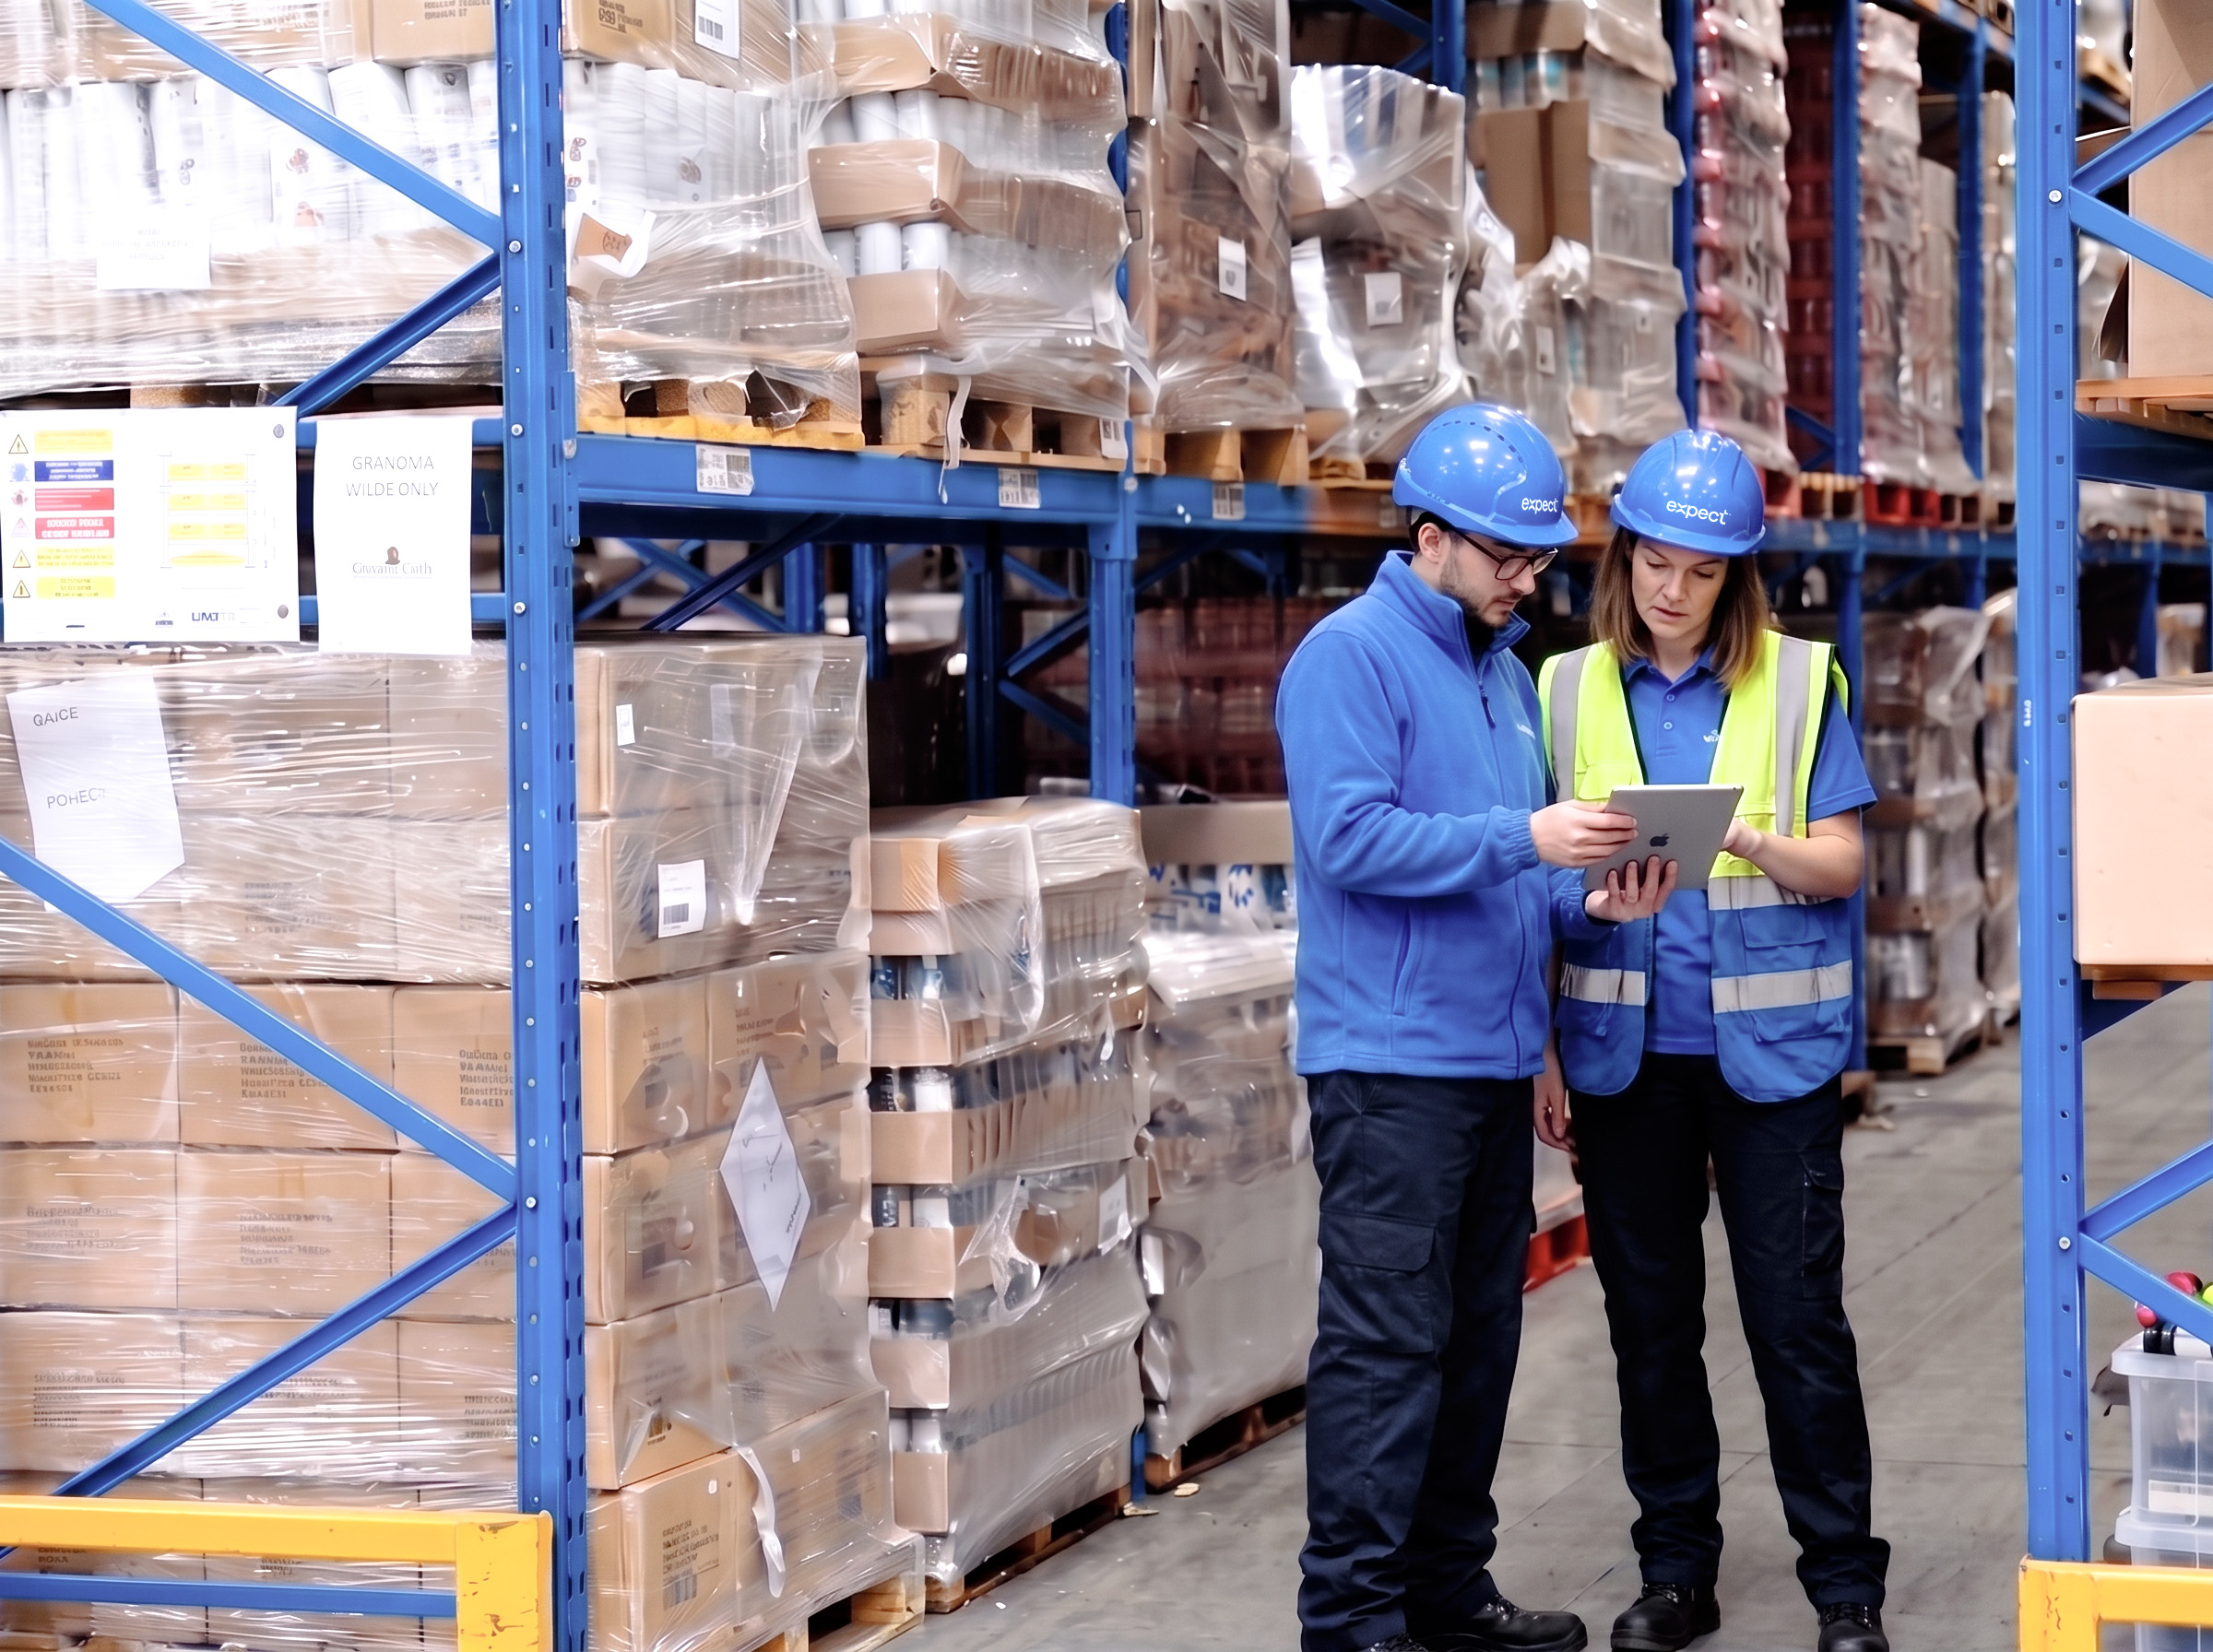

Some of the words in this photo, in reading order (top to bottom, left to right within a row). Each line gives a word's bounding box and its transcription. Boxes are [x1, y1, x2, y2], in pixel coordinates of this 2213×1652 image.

[352, 455, 434, 470] GRANOMA
[346, 482, 394, 497] WILDE
[398, 481, 439, 496] ONLY
[1521, 497, 1559, 514] expect
[1665, 500, 1729, 525] expect
[33, 706, 79, 726] QAICE
